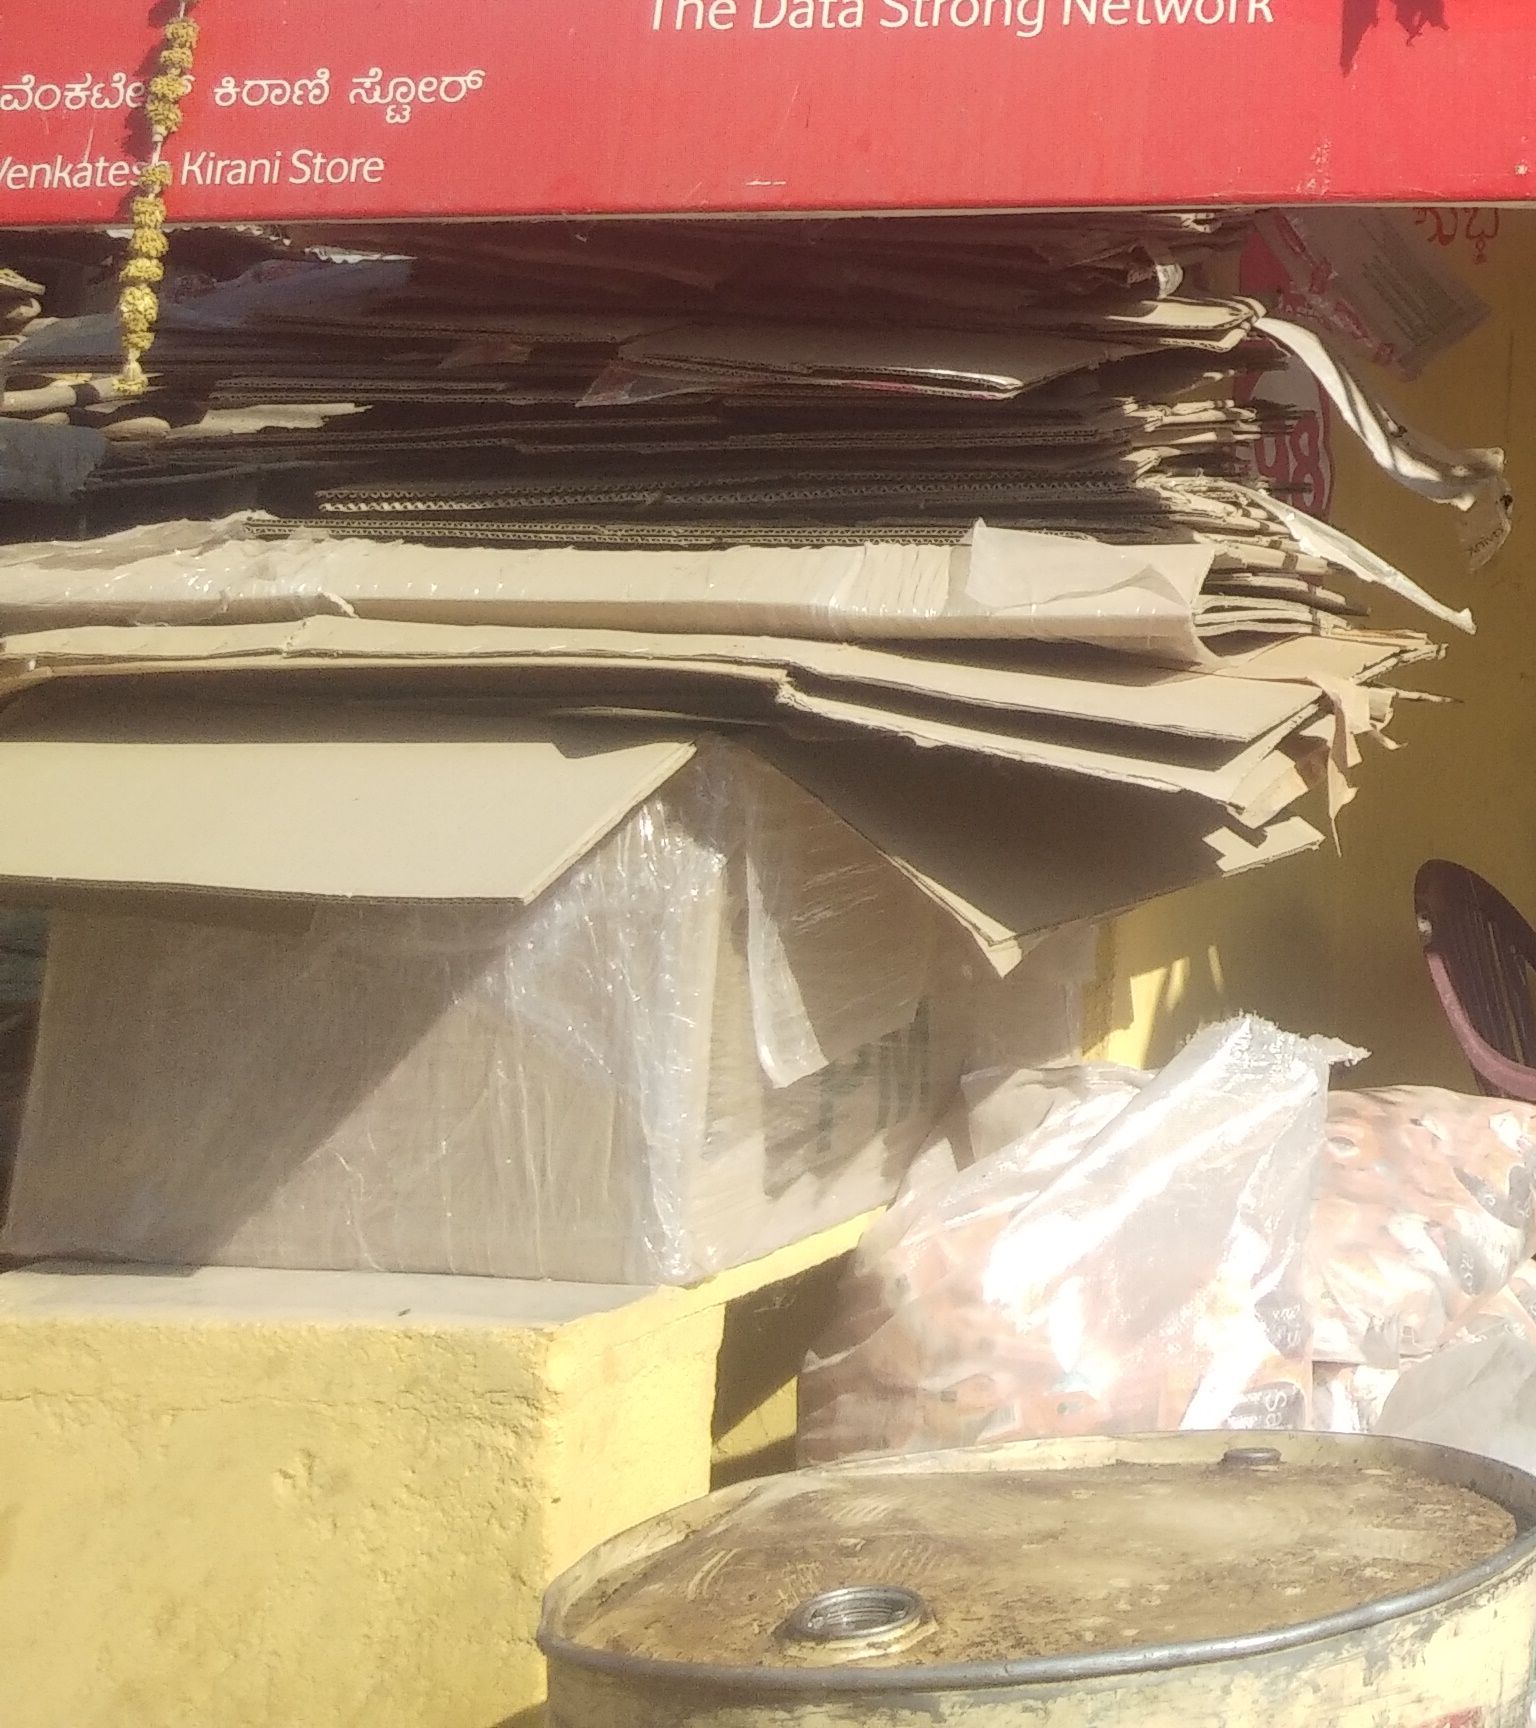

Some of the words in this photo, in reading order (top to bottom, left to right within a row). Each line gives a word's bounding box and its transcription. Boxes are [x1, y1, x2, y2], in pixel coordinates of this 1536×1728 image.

[213, 68, 331, 109] ಕಿರಾಣಿ
[0, 154, 172, 191] enkates
[180, 149, 282, 186] Kirani
[289, 148, 385, 185] Store
